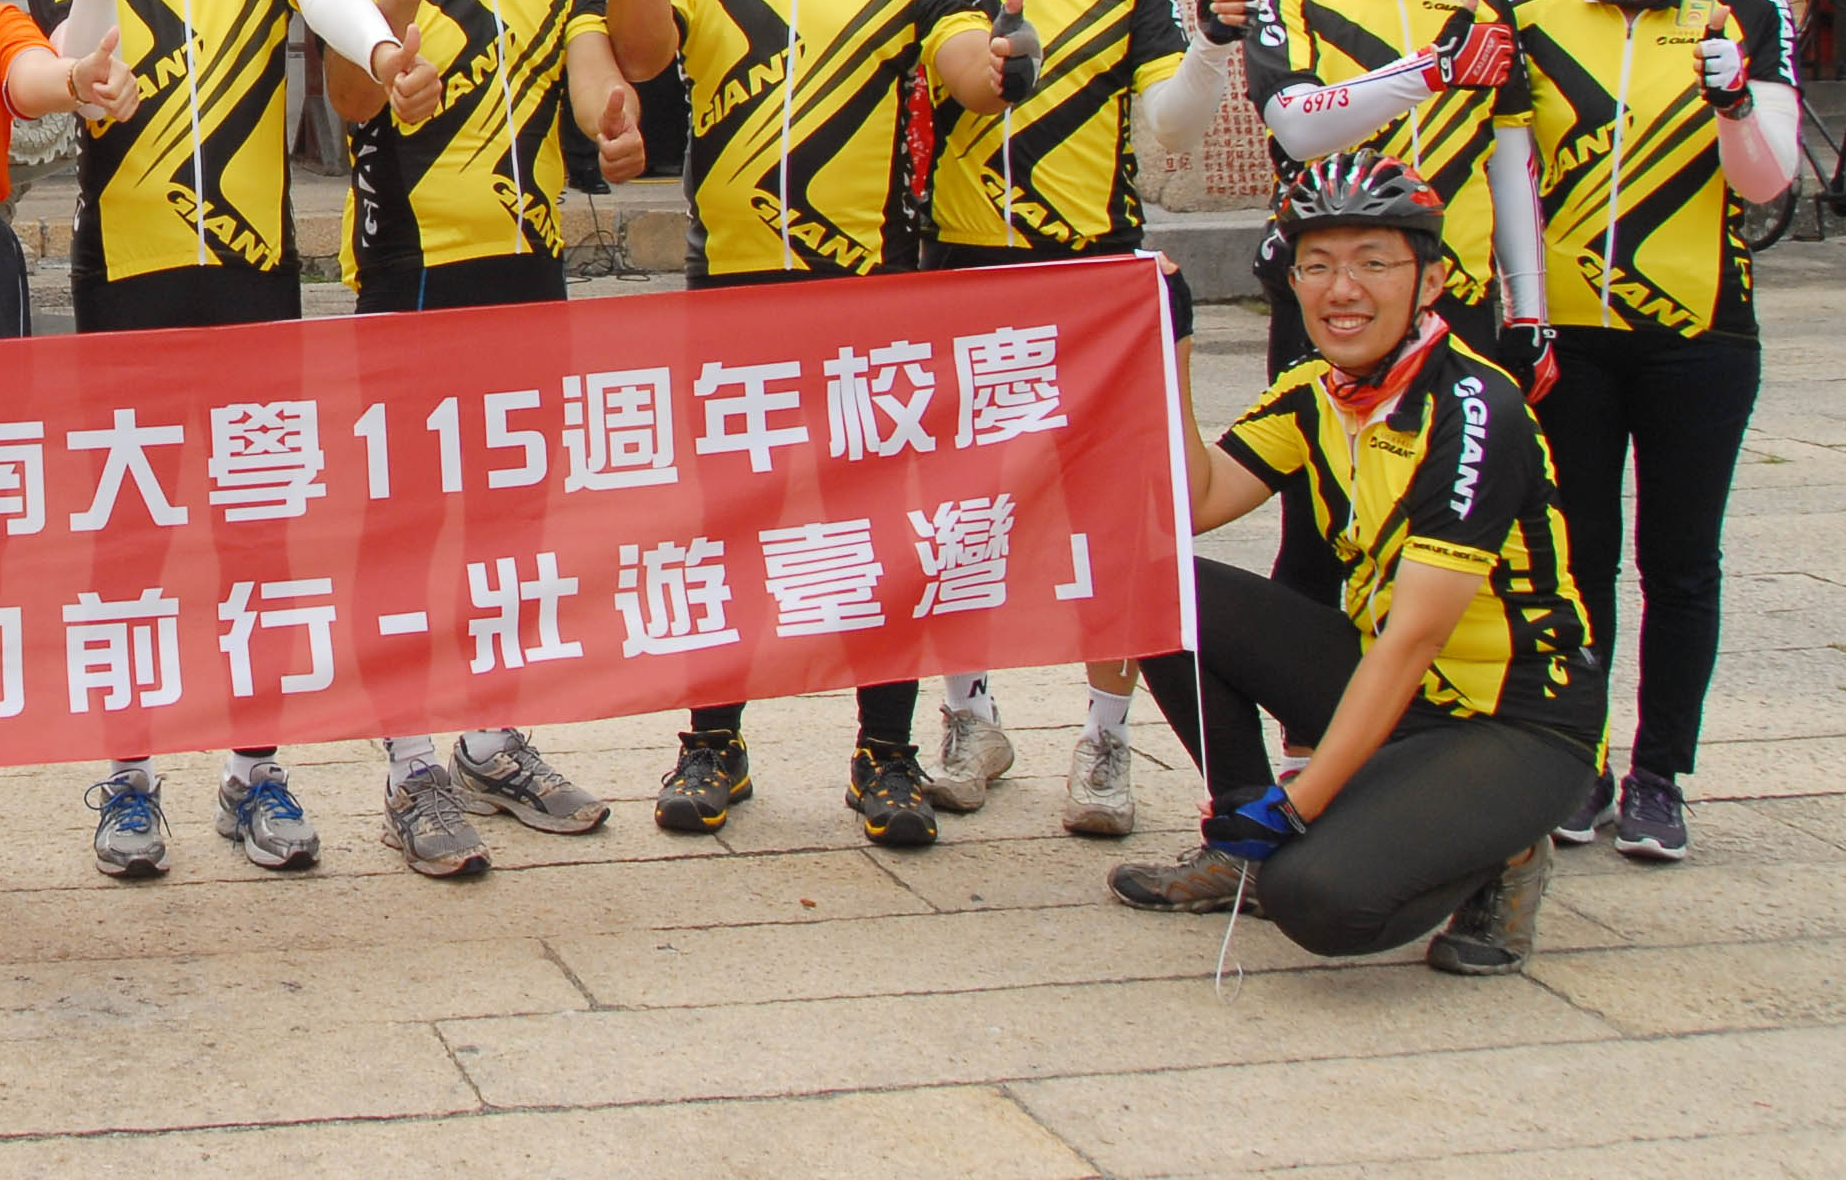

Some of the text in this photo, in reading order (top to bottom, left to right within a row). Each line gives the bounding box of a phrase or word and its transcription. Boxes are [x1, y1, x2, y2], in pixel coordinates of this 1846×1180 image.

[694, 38, 807, 139] GIANT
[1302, 86, 1351, 115] 6973
[167, 187, 283, 273] GIANT
[491, 180, 566, 260] GIANT
[749, 194, 883, 278] GIANT
[1577, 254, 1709, 340] GIANT
[1450, 394, 1489, 520] GIANT
